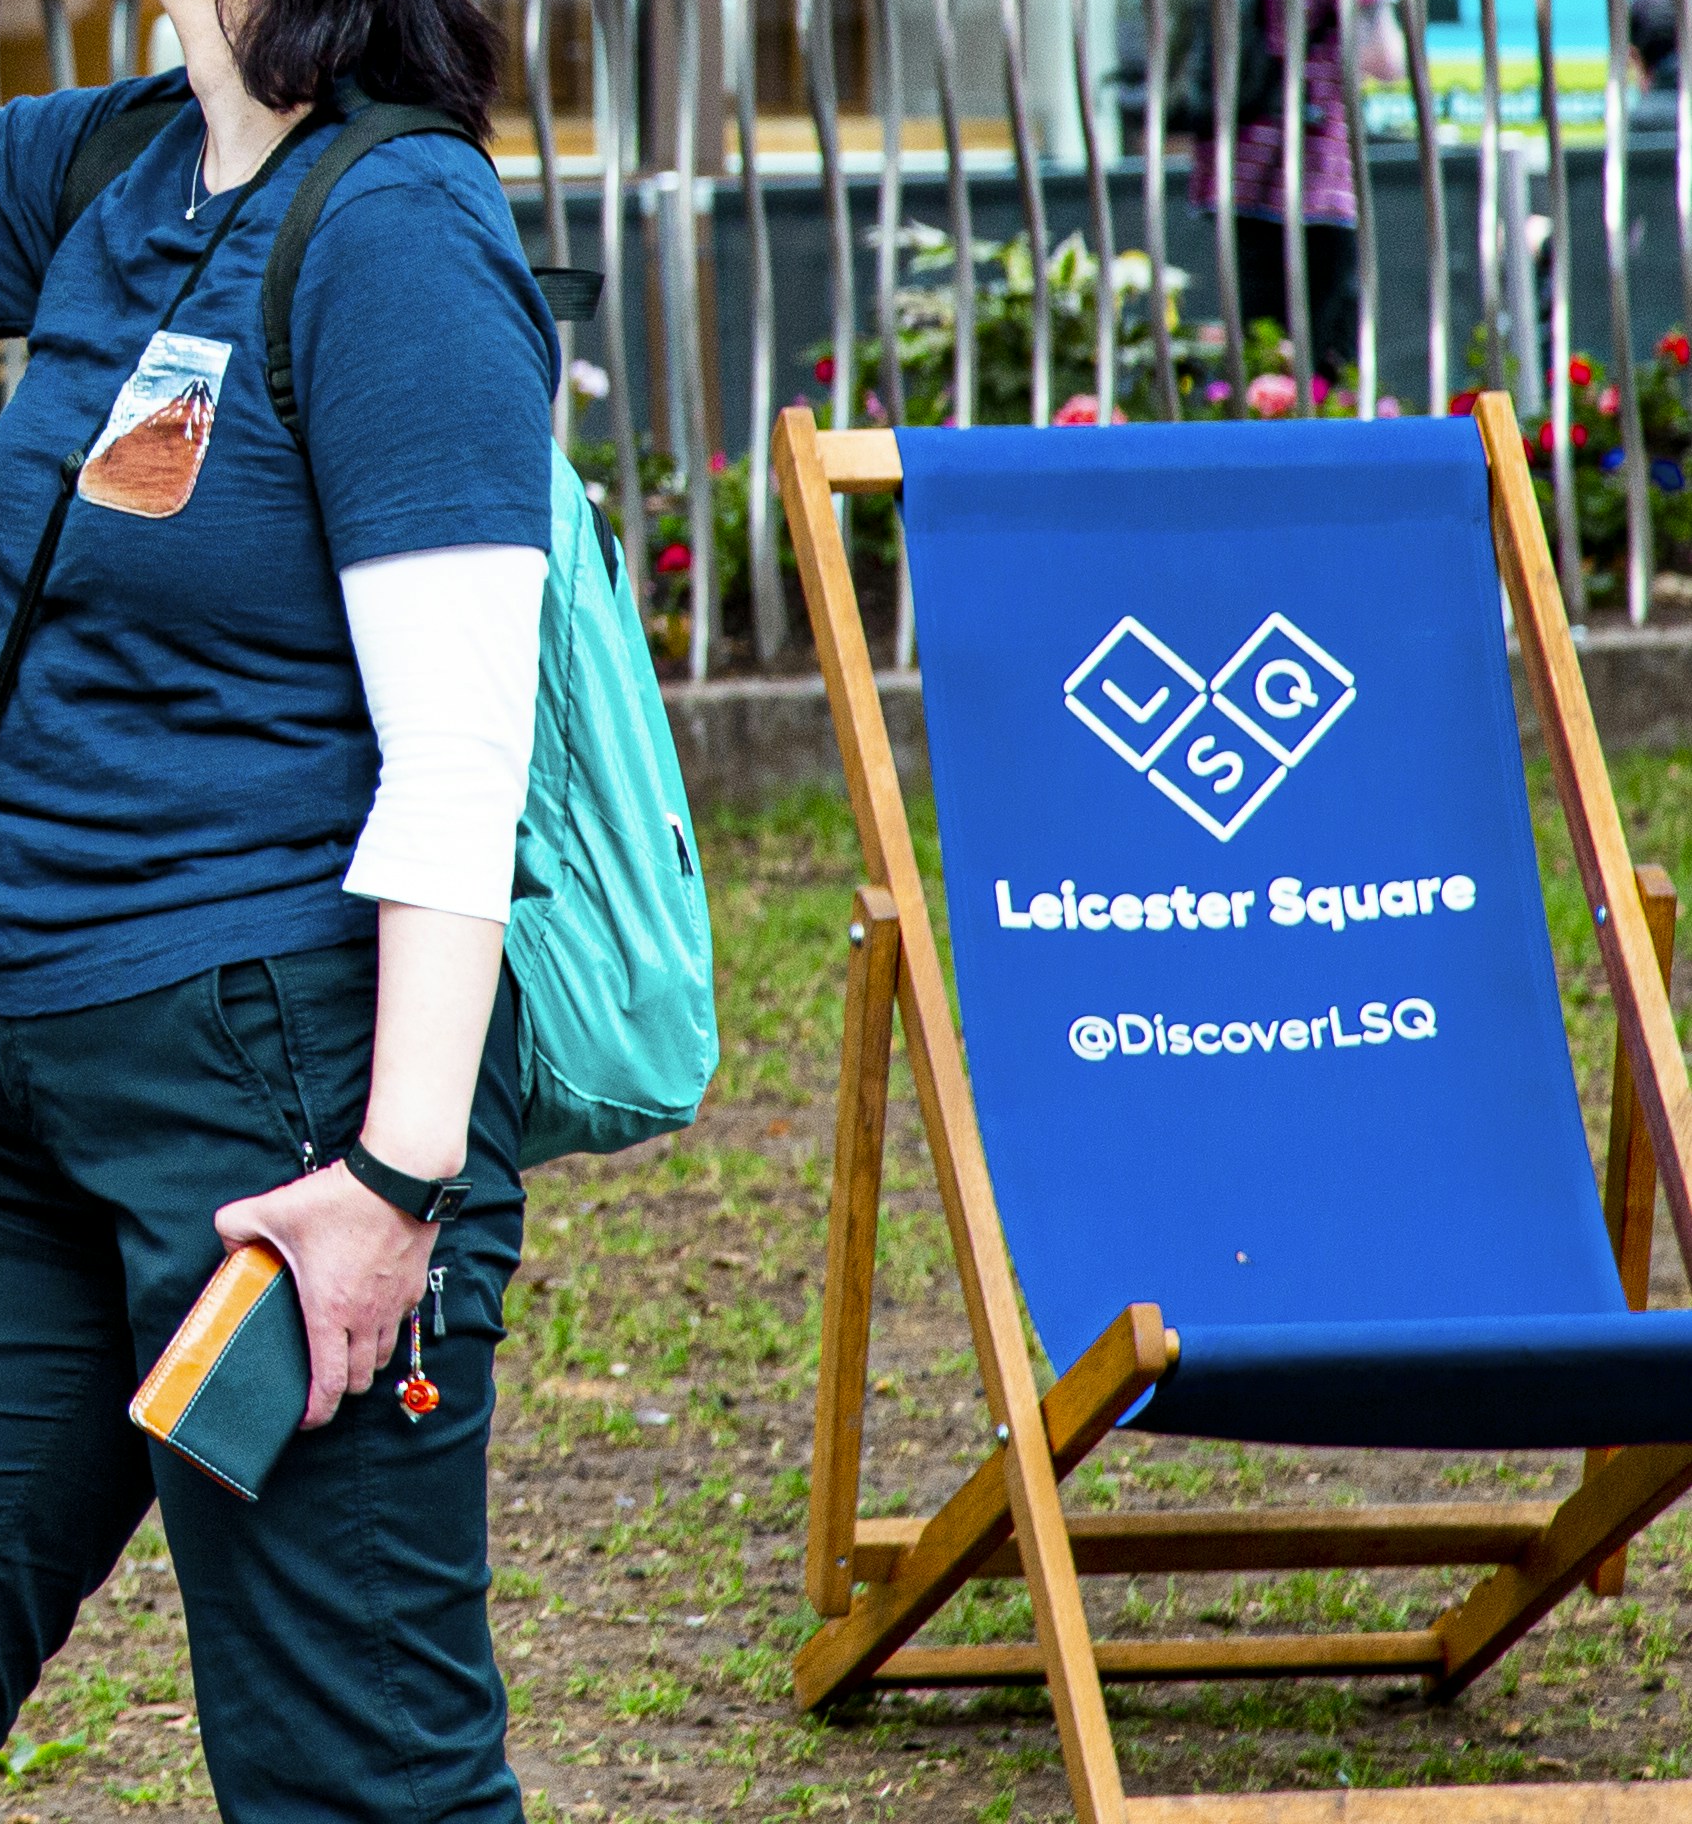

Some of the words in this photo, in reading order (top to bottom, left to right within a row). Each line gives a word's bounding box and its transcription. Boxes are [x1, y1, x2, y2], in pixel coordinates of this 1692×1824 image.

[994, 879, 1256, 931] Leicester
[1267, 873, 1477, 933] Square
[1067, 996, 1438, 1062] @DiscoverLSQ
